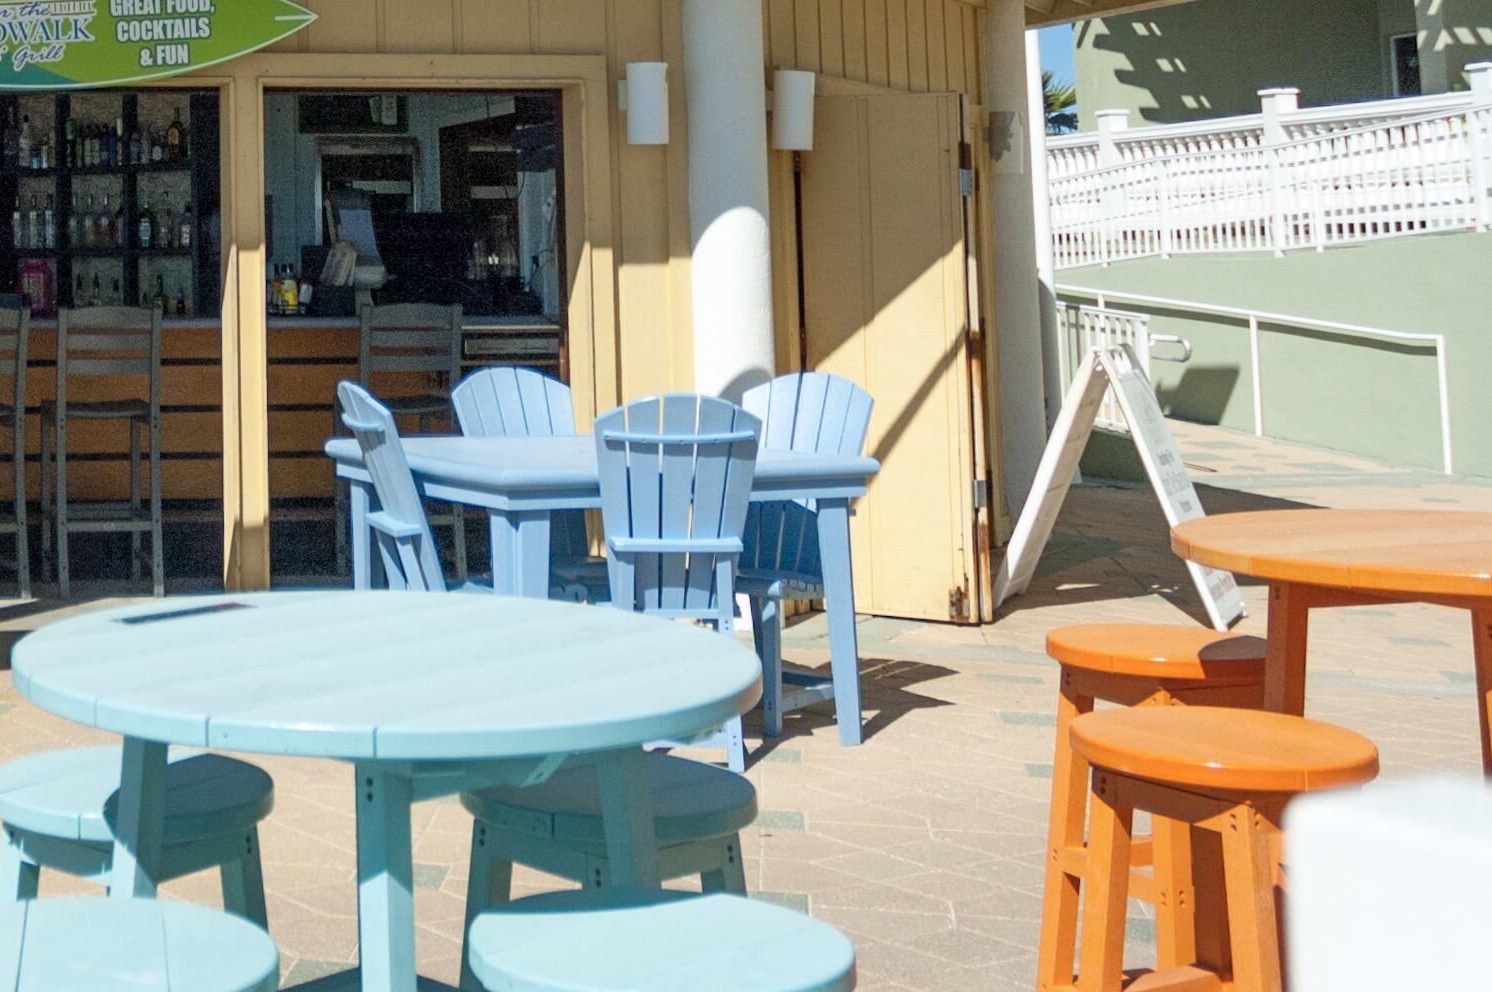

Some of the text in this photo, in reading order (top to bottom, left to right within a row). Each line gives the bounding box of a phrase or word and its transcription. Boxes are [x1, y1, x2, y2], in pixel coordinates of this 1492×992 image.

[19, 1, 51, 18] the
[117, 17, 211, 42] COCKTAILS
[13, 44, 63, 70] Grill
[140, 44, 189, 67] & FUN
